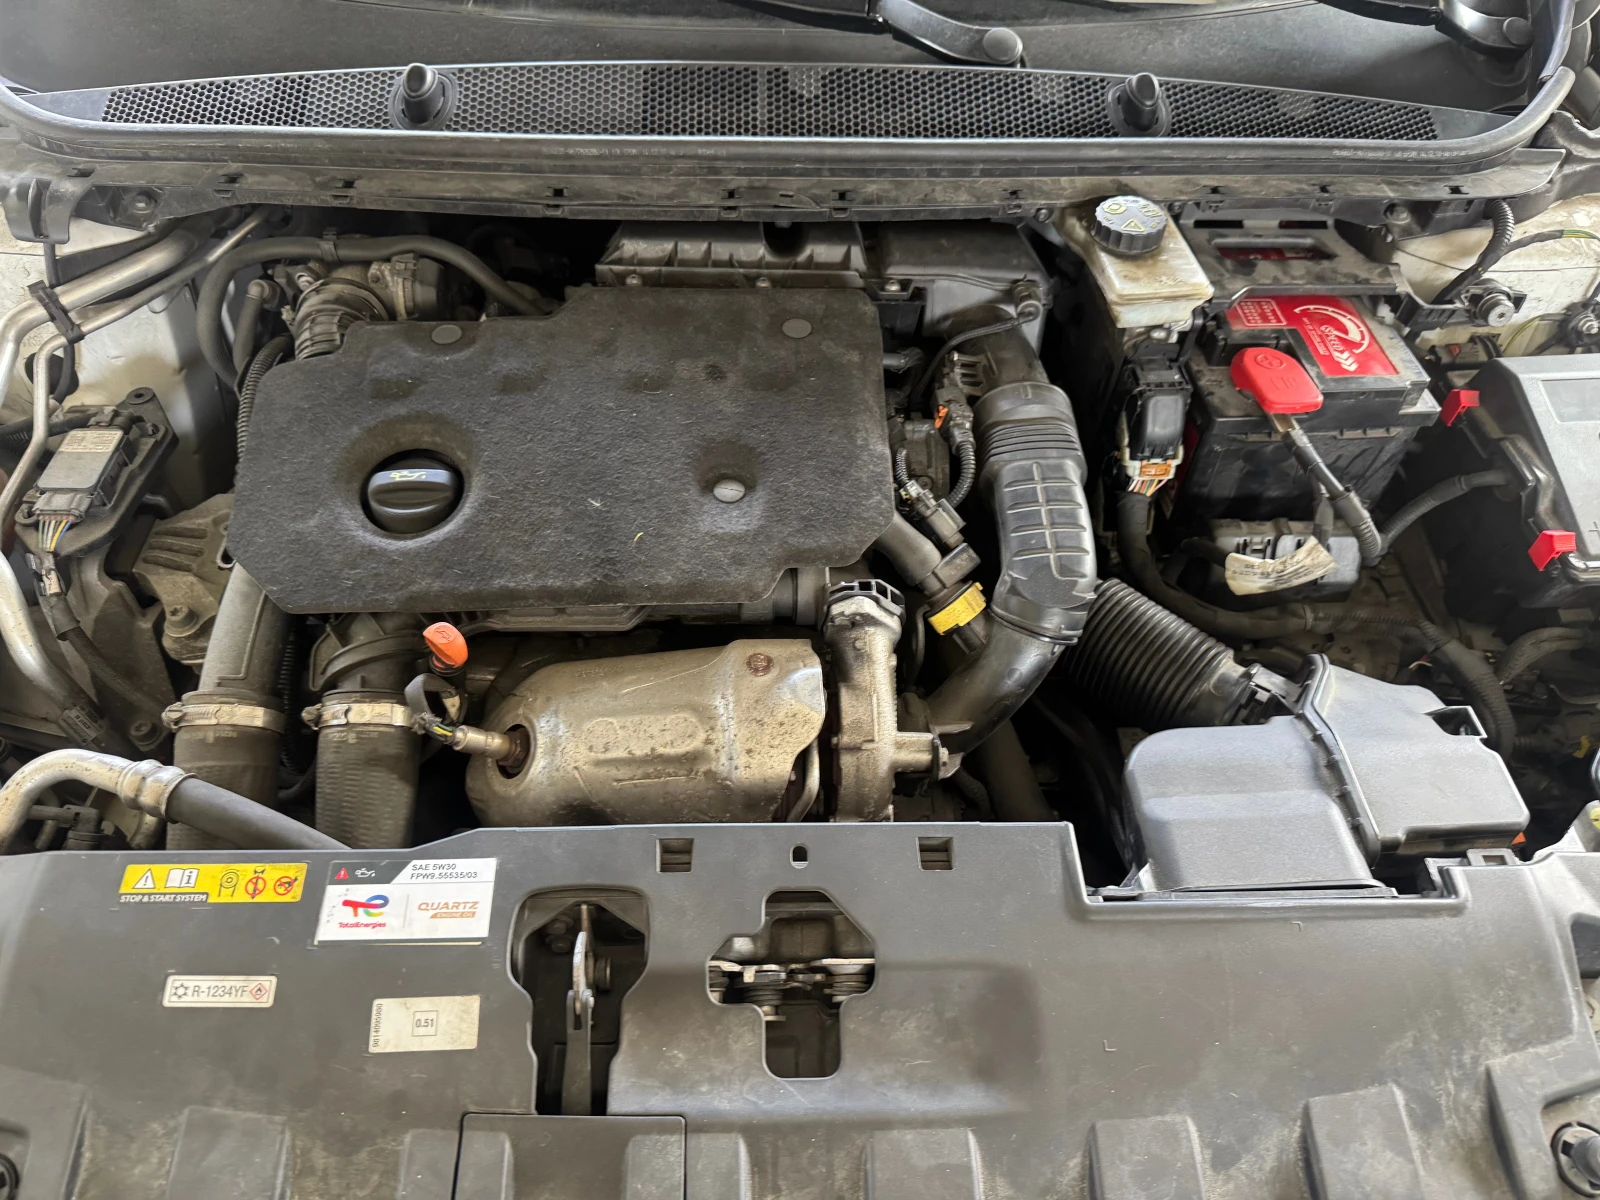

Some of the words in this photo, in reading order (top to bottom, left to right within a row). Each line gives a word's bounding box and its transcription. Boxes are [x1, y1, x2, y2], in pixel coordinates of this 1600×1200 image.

[432, 863, 457, 871] 5W30
[410, 871, 478, 880] FPW9.55535/03
[120, 894, 142, 902] STOP
[149, 894, 176, 902] START
[176, 894, 207, 902] SYSTEM
[417, 901, 480, 911] QUARTZ
[338, 921, 387, 929] TotalEnergies
[191, 985, 249, 998] R-1234YF
[415, 1018, 434, 1028] 0.51
